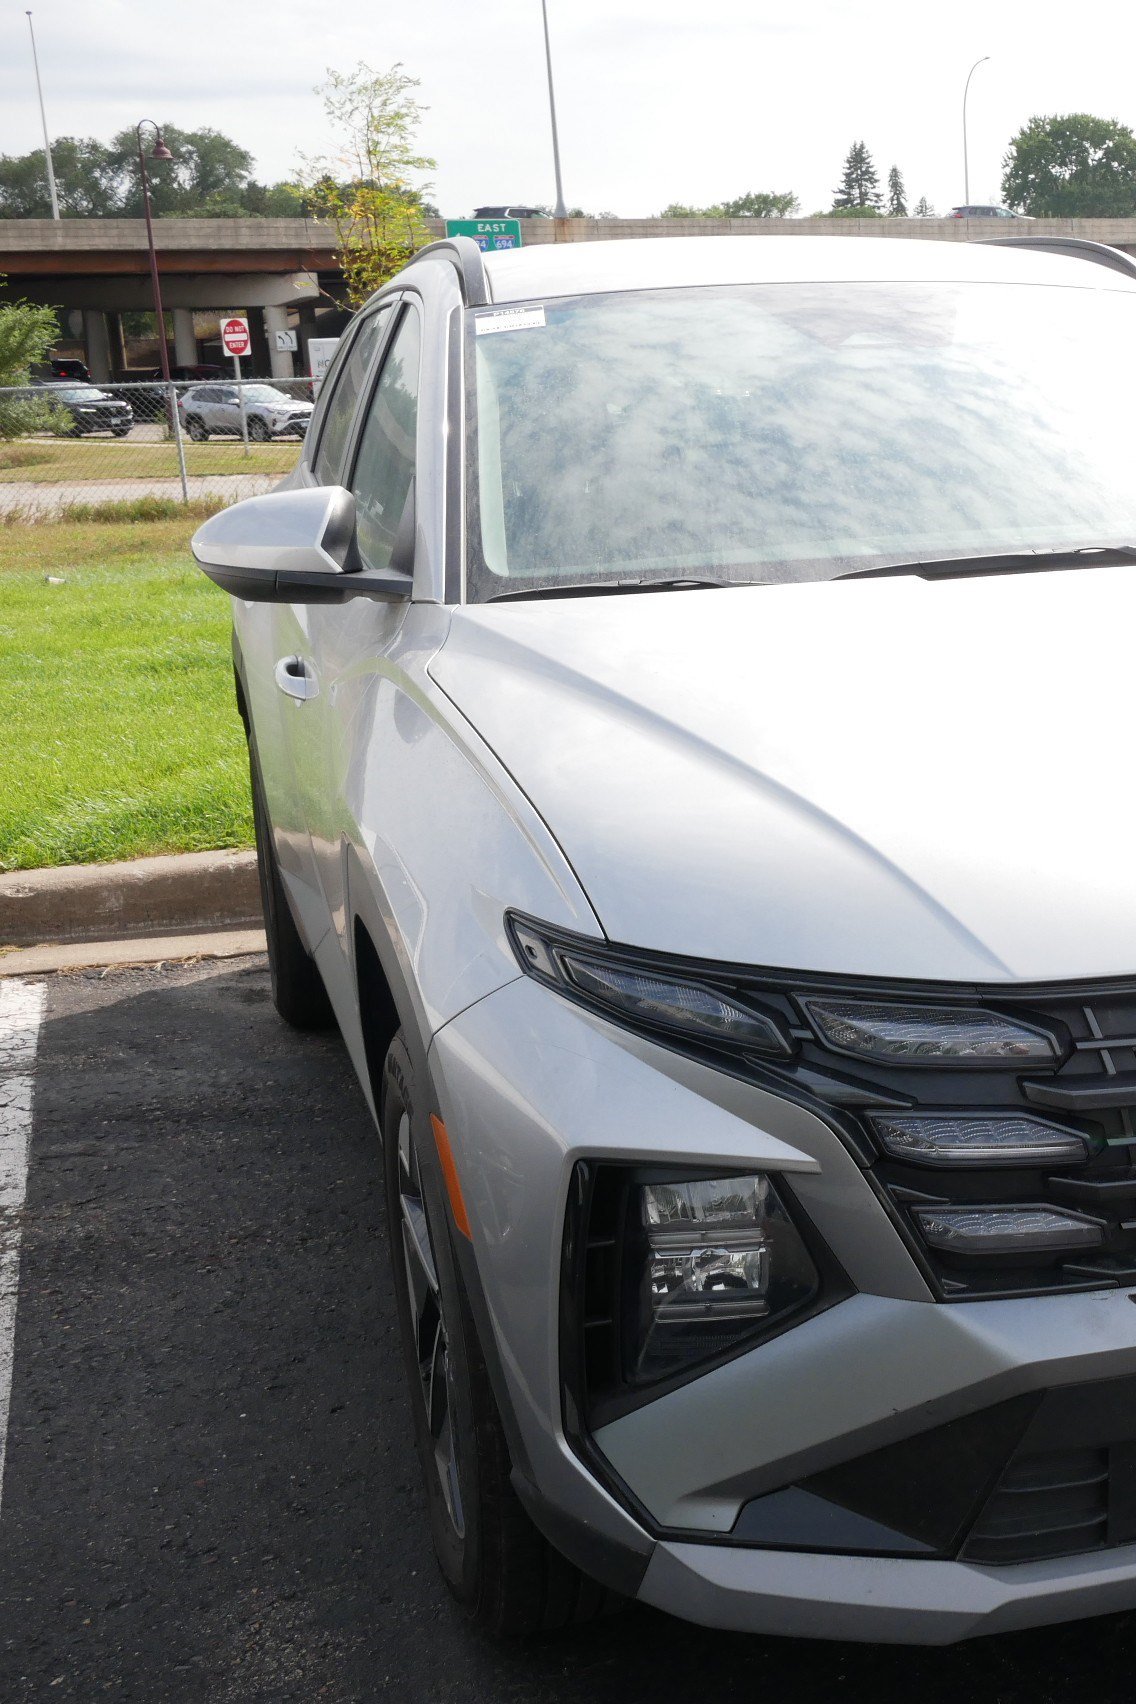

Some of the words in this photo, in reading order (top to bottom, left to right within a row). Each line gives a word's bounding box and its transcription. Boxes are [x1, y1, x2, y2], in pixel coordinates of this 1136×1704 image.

[477, 223, 506, 232] EAST
[496, 240, 512, 249] 694
[229, 341, 245, 349] ENTER
